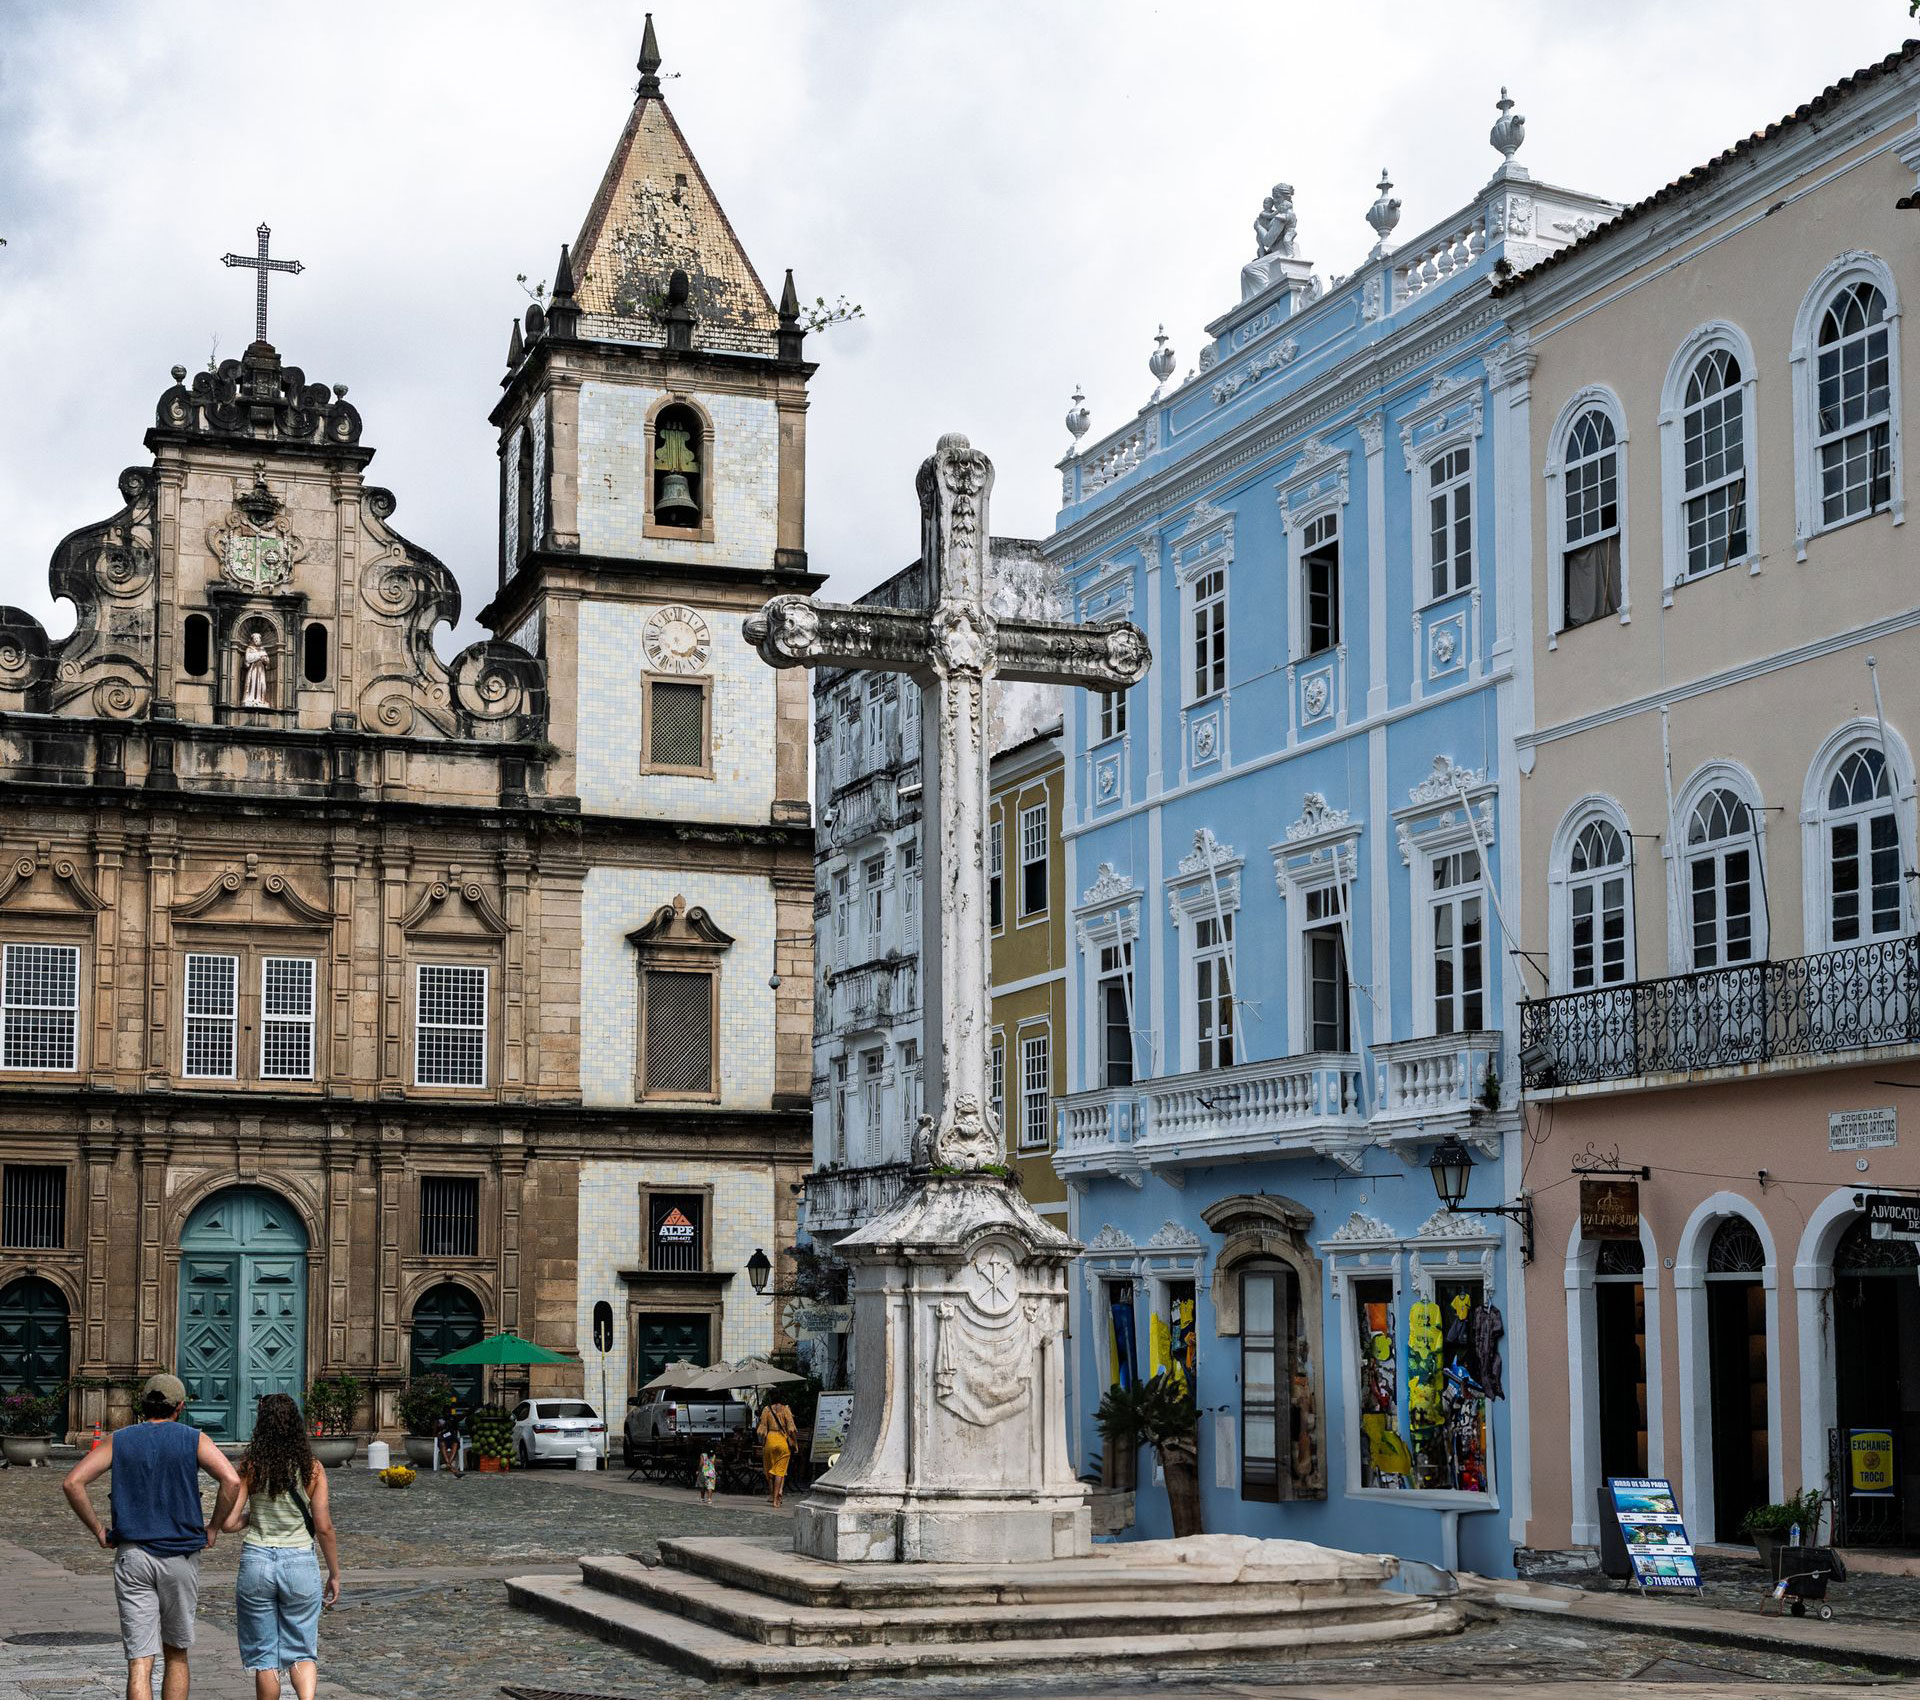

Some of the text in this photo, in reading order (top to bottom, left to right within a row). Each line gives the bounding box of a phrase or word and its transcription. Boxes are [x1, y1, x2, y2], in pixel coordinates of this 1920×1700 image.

[1840, 1111, 1884, 1123] SOCIEDADE
[1830, 1123, 1849, 1138] MONTE
[1858, 1121, 1869, 1136] DOS
[1870, 1119, 1895, 1135] ARTISTAS
[1871, 1205, 1920, 1221] ADVOCATU
[659, 1225, 694, 1236] ALPE
[1852, 1439, 1891, 1452] EXCHANGE
[1859, 1471, 1885, 1483] TROCO
[1653, 1576, 1661, 1586] 71
